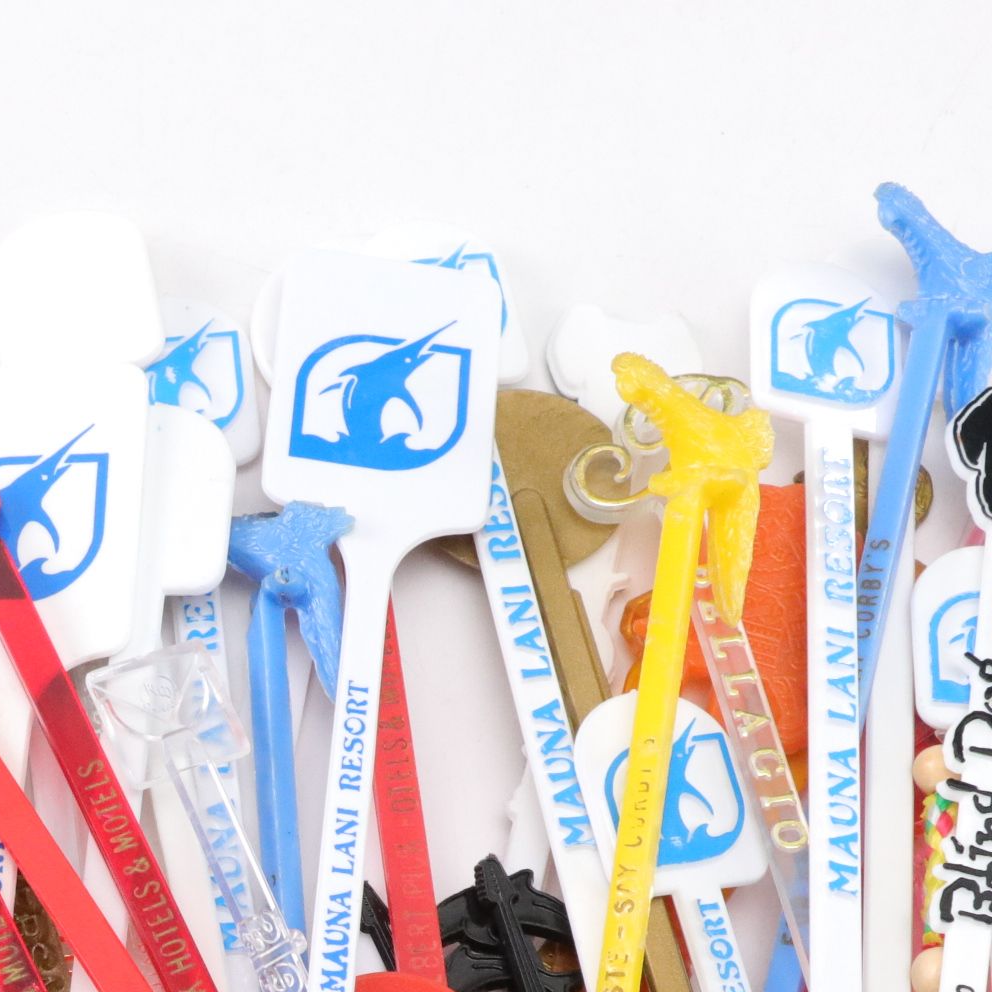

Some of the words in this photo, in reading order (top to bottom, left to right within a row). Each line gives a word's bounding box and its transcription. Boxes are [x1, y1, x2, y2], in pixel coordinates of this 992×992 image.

[823, 448, 856, 604] RESORT
[500, 585, 553, 681] LANI
[825, 626, 857, 725] LANI
[338, 679, 371, 794] RESORT
[532, 699, 595, 849] MAUNA
[77, 758, 141, 856] MOTELS
[331, 806, 361, 881] LANI
[827, 746, 859, 897] MAUNA
[123, 856, 154, 875] &
[133, 879, 196, 976] HOTELS
